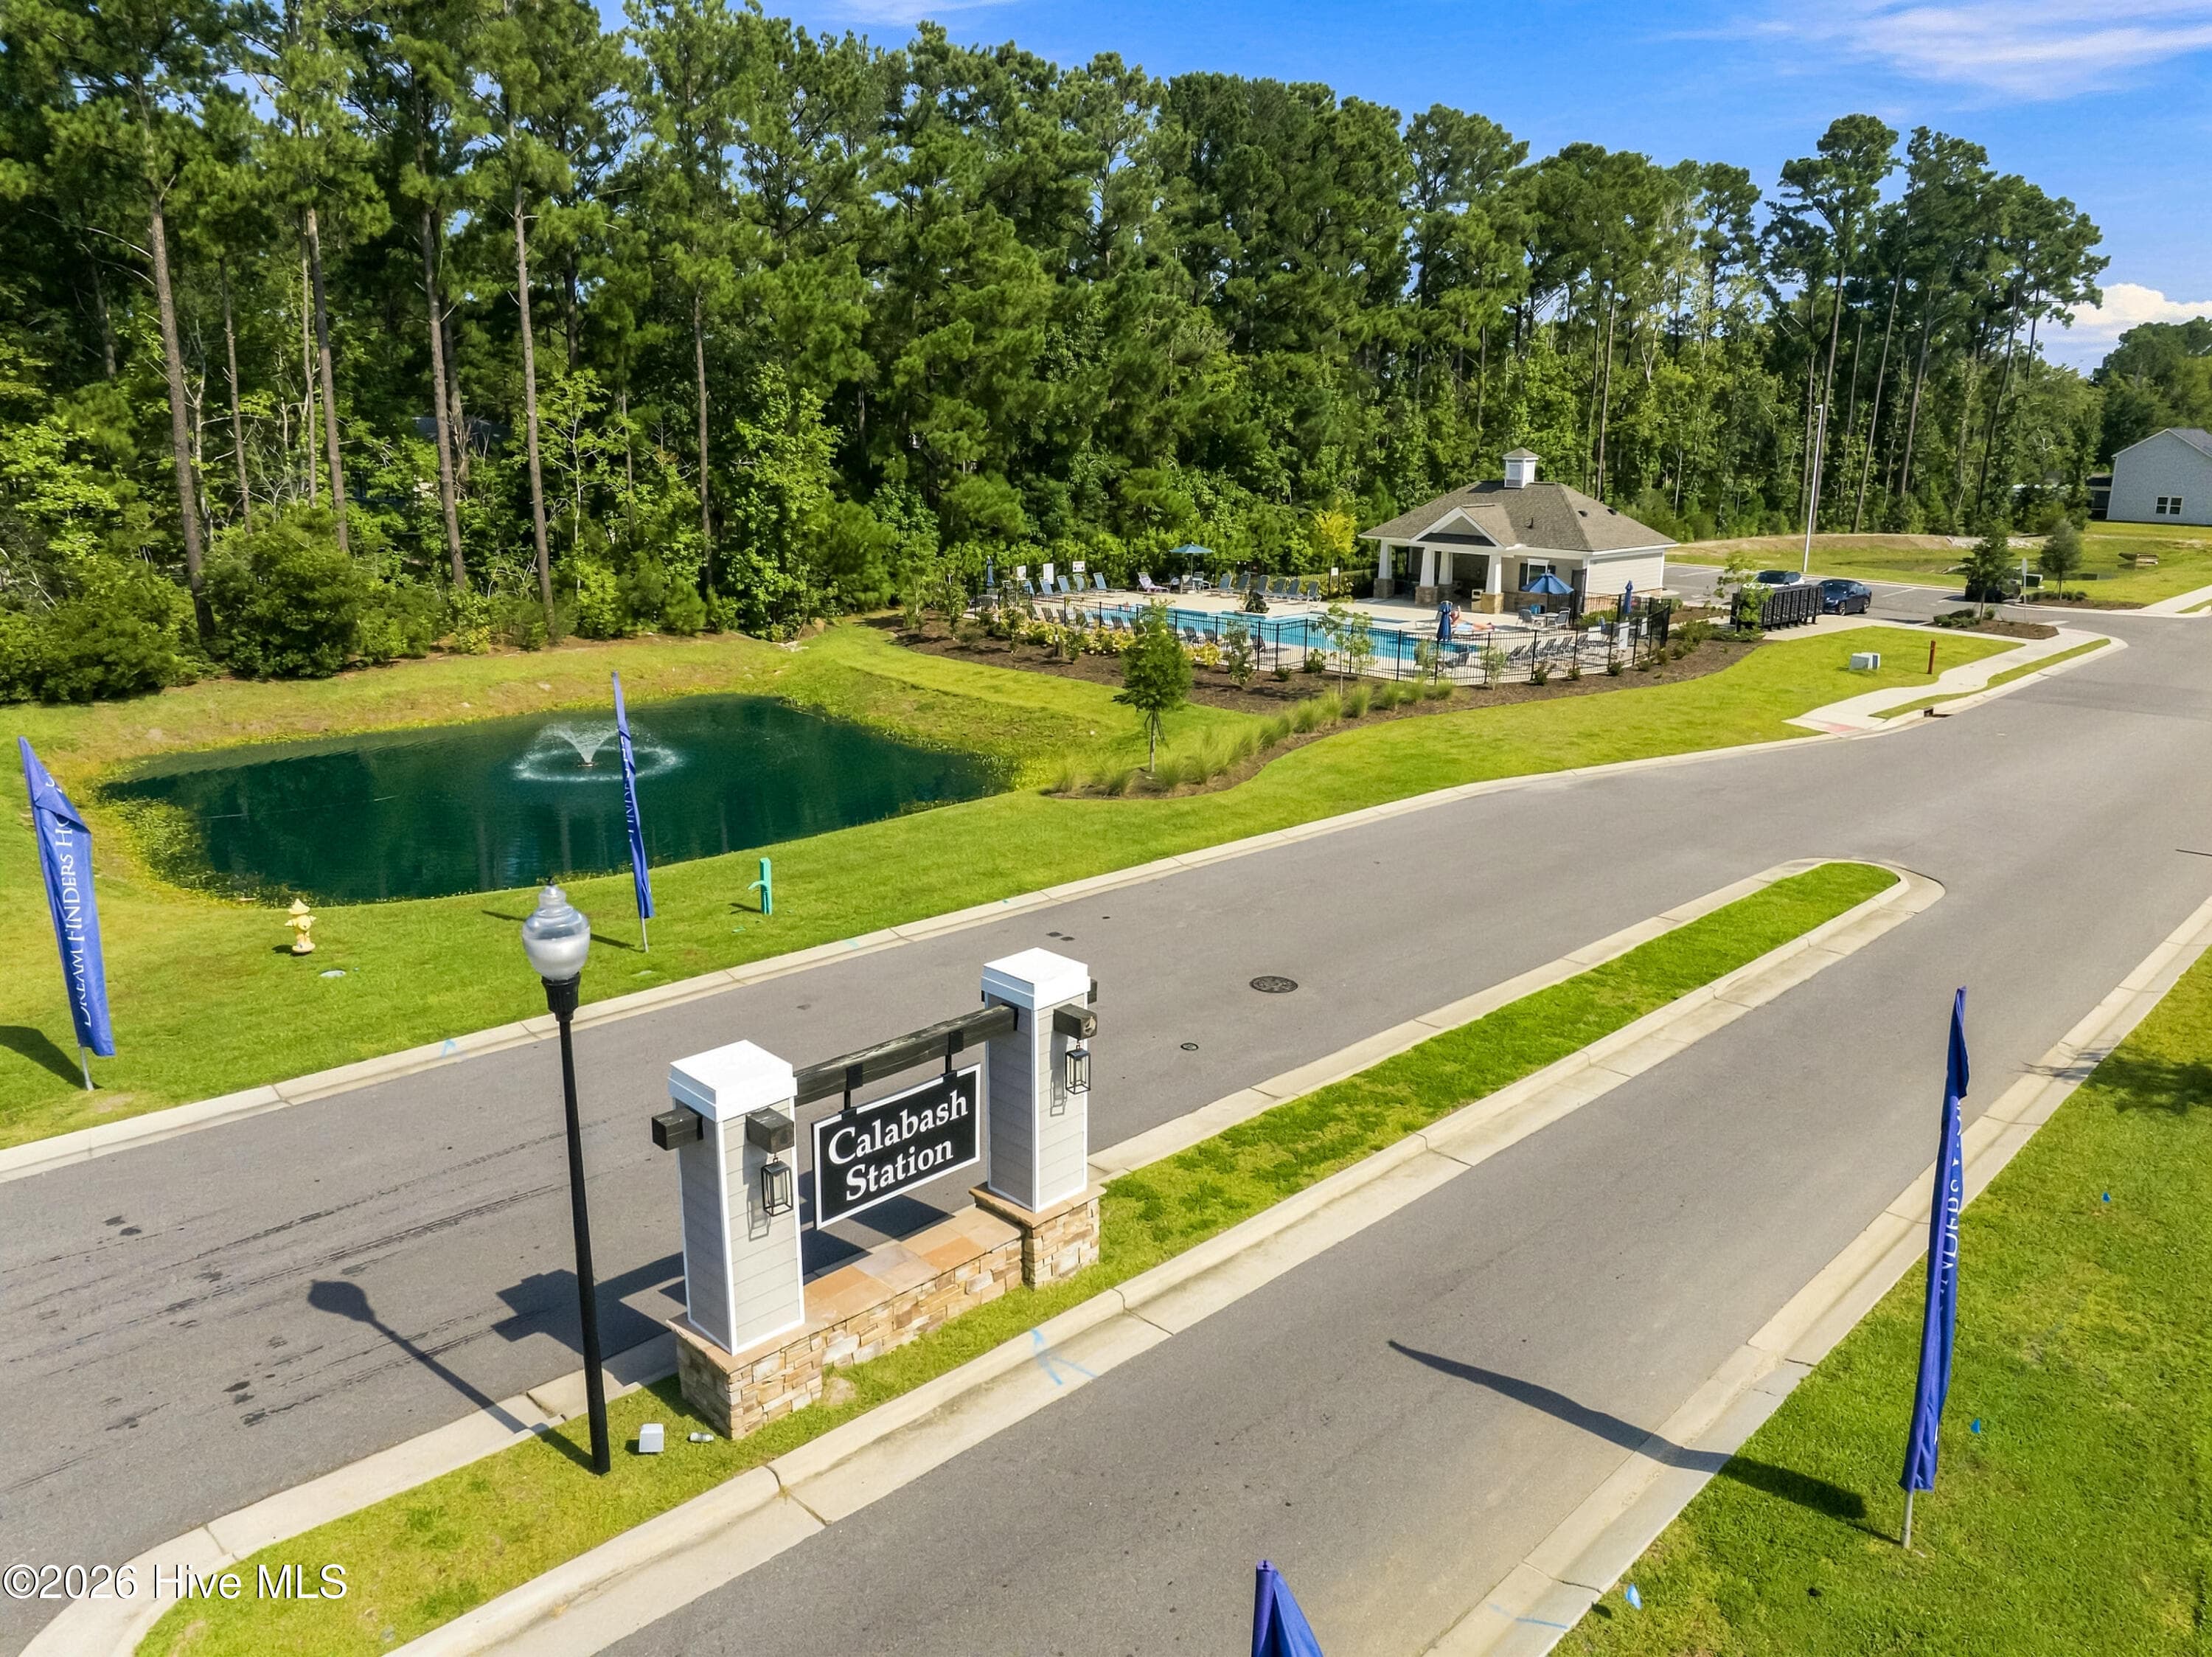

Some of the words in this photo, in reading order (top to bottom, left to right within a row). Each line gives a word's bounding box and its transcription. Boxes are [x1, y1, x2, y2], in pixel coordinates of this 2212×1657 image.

[60, 853, 85, 942] FINDERS
[828, 1089, 968, 1164] Calabash
[846, 1139, 953, 1201] Station
